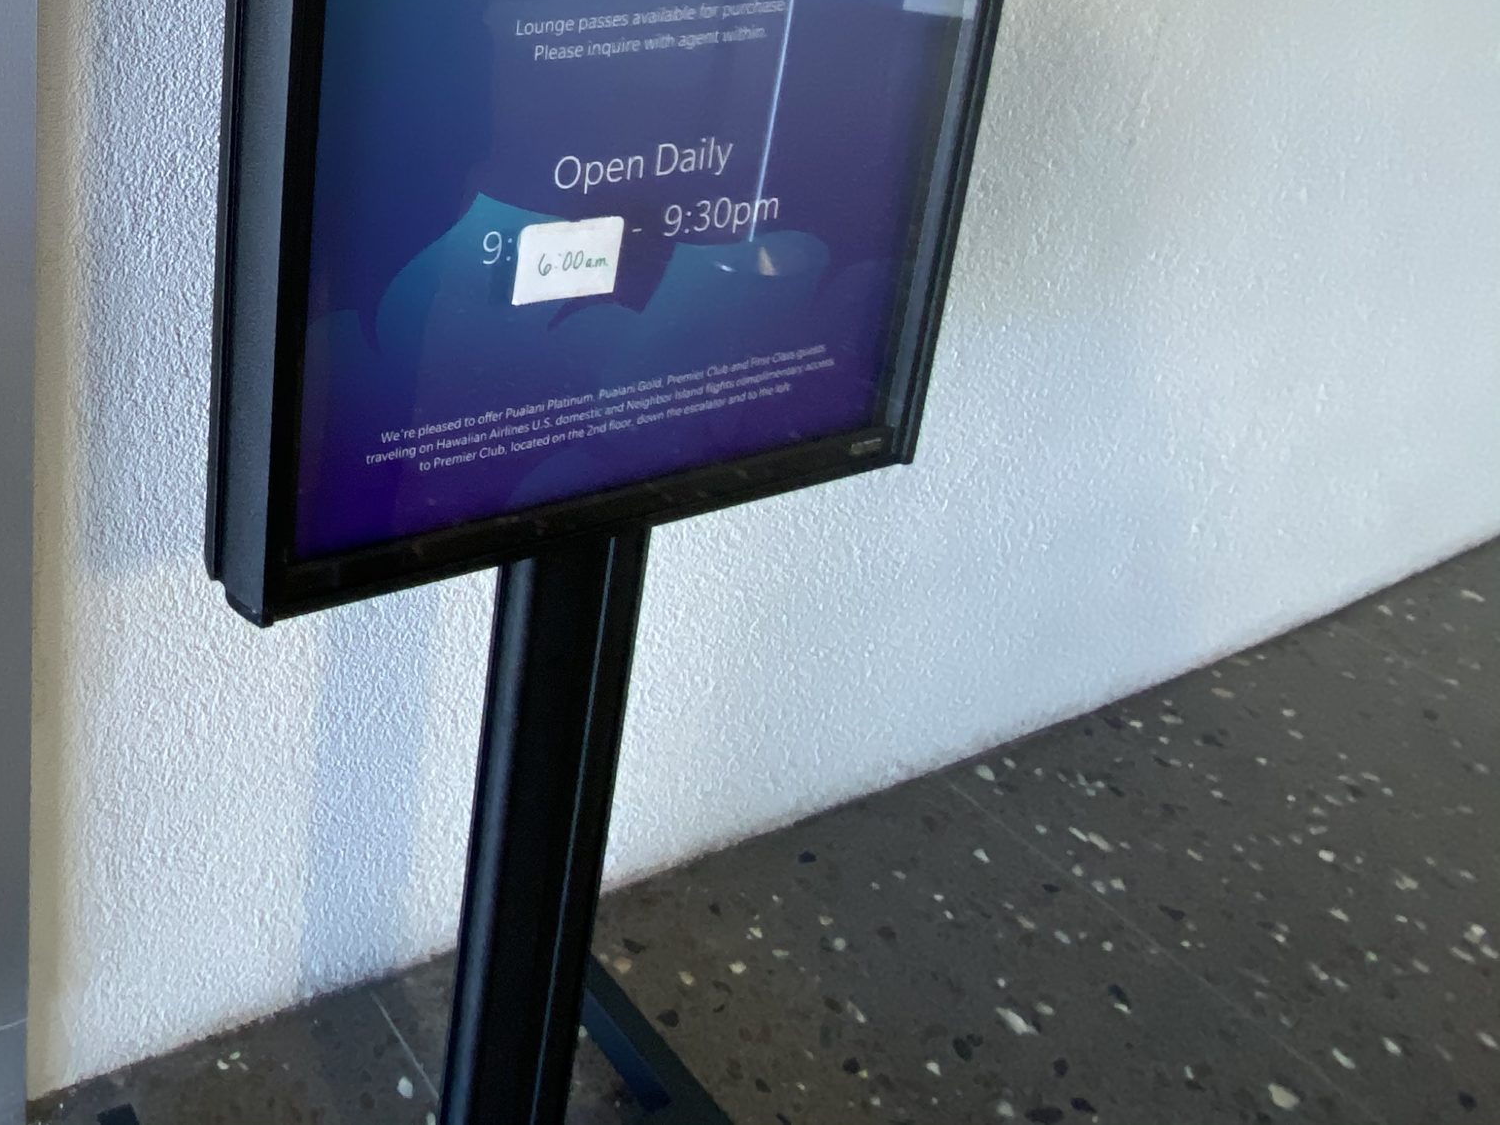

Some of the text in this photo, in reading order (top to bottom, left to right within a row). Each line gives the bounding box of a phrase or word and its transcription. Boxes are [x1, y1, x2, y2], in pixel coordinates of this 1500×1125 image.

[515, 17, 575, 37] Lounge
[578, 14, 629, 34] passes
[632, 3, 697, 25] available
[699, 2, 718, 19] for
[534, 44, 584, 61] Please
[586, 38, 641, 57] inquire
[643, 32, 675, 50] with
[678, 29, 720, 50] agent
[554, 136, 734, 195] Open Daily
[663, 196, 779, 237] 9:30pm
[365, 445, 417, 465] traveling
[419, 442, 434, 454] on
[436, 431, 488, 450] Hawaiian
[488, 423, 530, 440] Airlines
[532, 416, 553, 431] U.S.
[555, 407, 602, 426] domestic
[604, 402, 625, 415] and
[380, 428, 416, 444] We're
[418, 418, 461, 439] pleased
[464, 416, 476, 428] to
[477, 410, 504, 425] offer
[419, 460, 431, 471] to
[433, 450, 478, 469] Premier
[510, 434, 550, 452] located
[551, 432, 566, 444] on
[567, 428, 585, 441] the
[586, 421, 607, 436] 2nd
